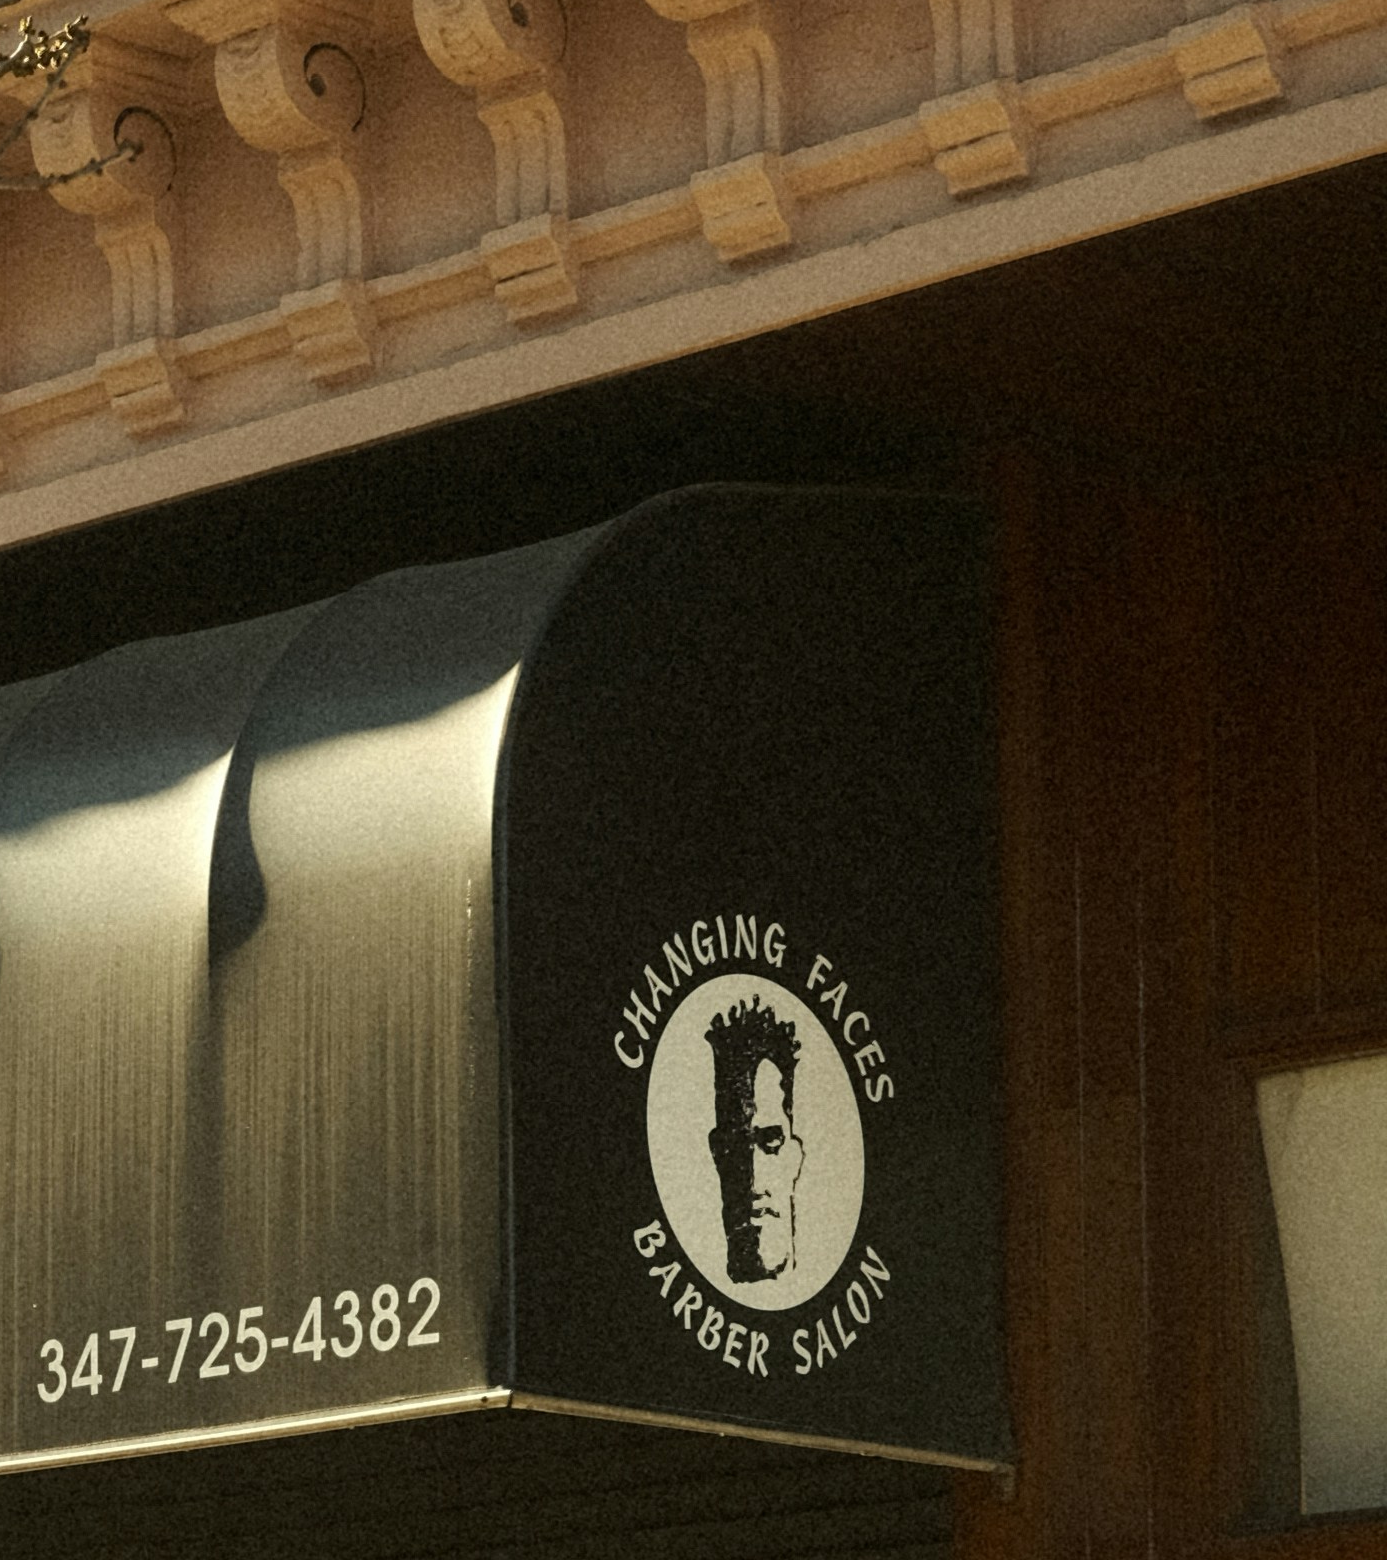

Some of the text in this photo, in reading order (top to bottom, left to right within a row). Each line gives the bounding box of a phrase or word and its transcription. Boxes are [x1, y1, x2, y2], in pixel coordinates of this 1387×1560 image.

[614, 914, 895, 1102] CHANGING FACES
[37, 1277, 441, 1403] 347-725-4382
[633, 1220, 891, 1377] BARBER SALON
